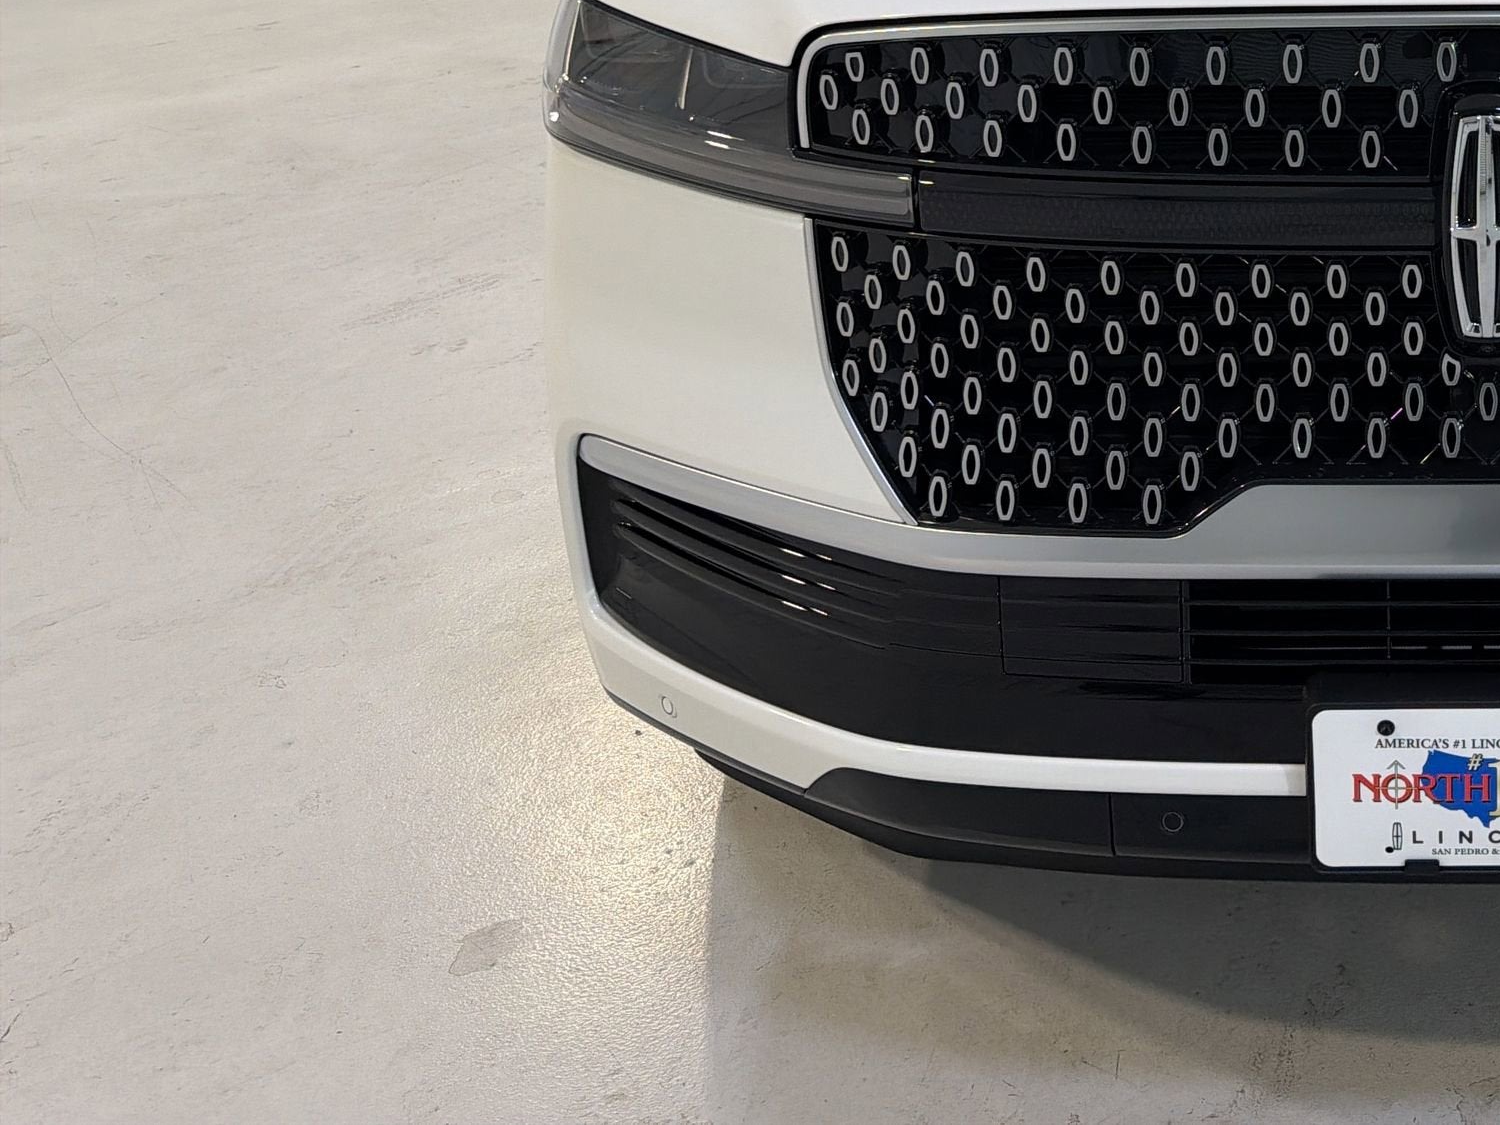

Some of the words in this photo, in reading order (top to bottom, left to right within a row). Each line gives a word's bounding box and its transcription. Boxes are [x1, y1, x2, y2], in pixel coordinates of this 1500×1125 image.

[1375, 738, 1449, 749] AMERICA'S
[1453, 738, 1468, 749] #1
[1352, 773, 1491, 803] NORTH
[1431, 848, 1453, 856] SAN
[1454, 848, 1490, 856] PEDRO
[1492, 848, 1500, 856] &
